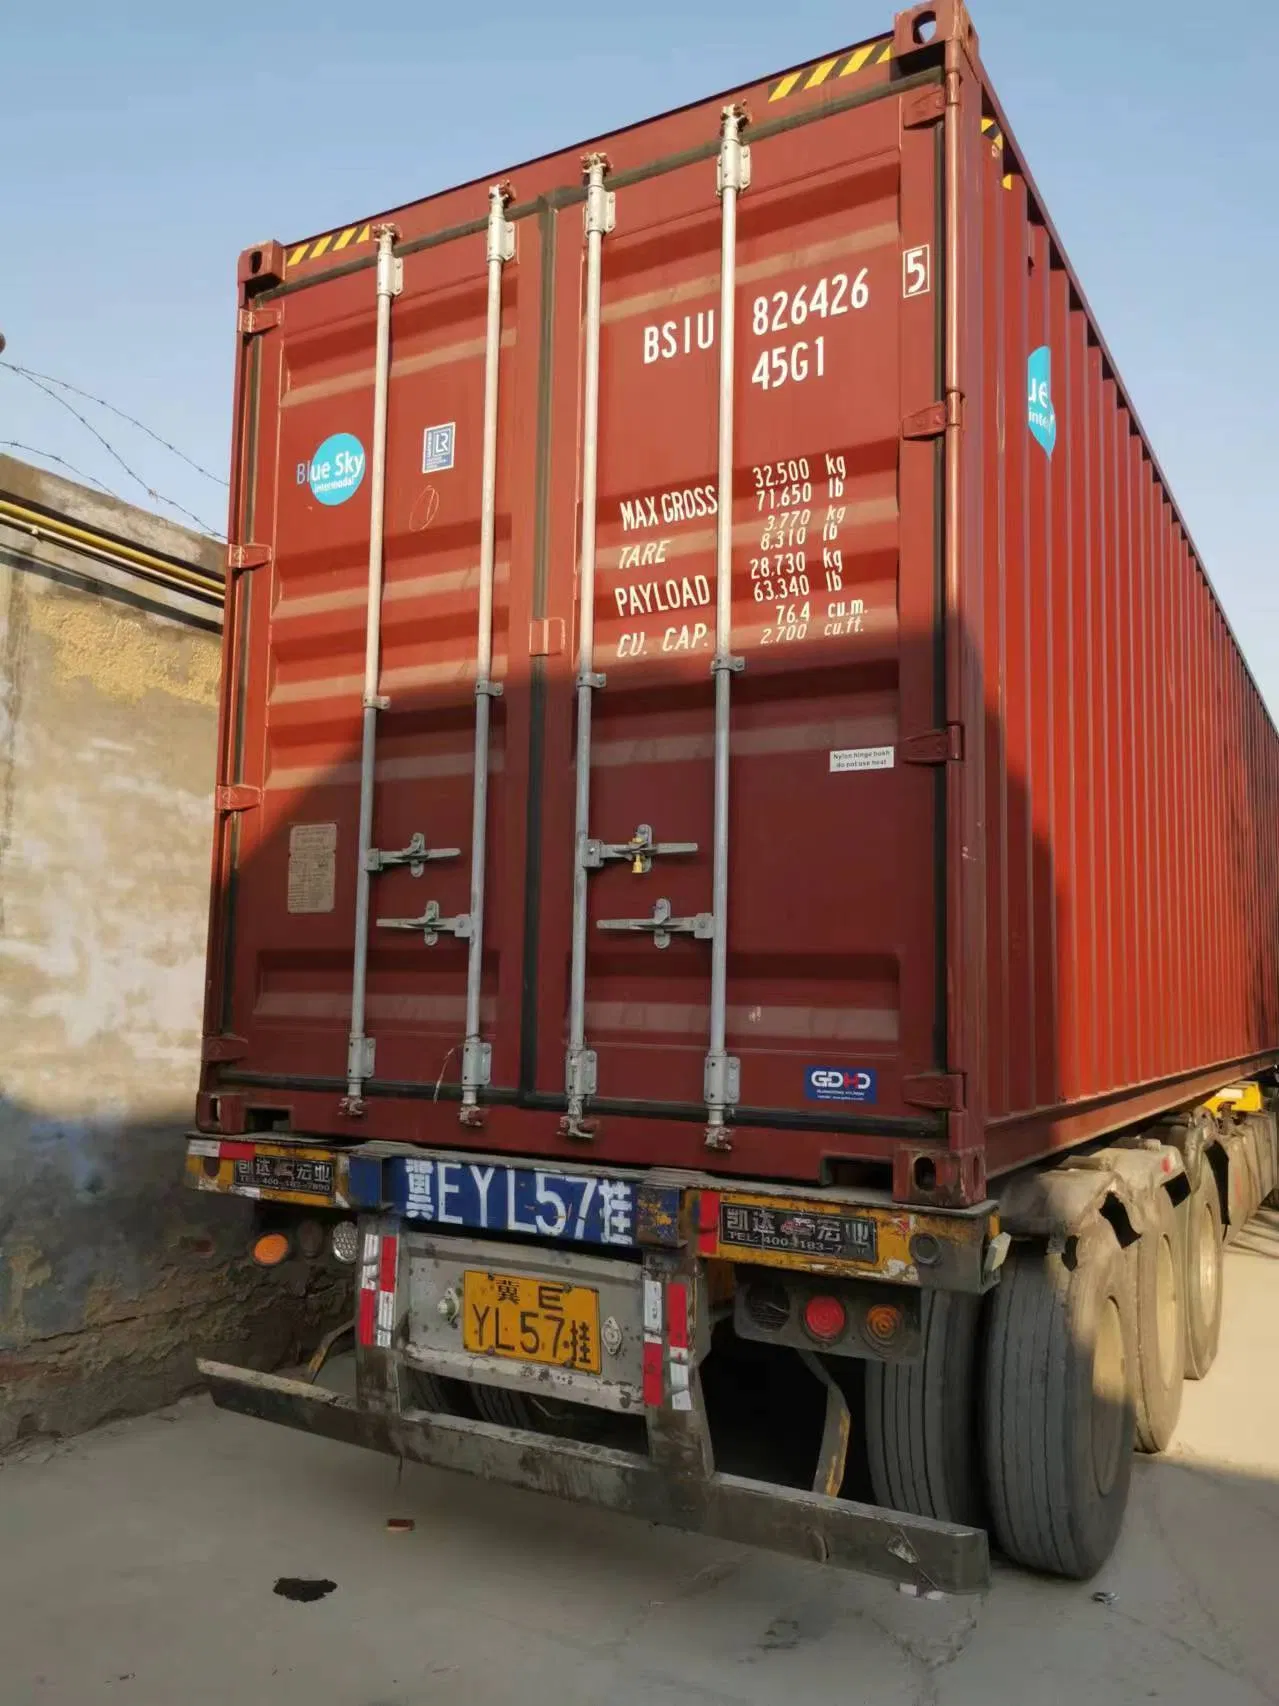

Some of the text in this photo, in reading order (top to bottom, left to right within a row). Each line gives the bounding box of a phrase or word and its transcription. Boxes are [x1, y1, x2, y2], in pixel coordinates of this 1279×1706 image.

[643, 248, 927, 364] BSIU 826426 5
[752, 336, 824, 390] 45G1
[296, 450, 364, 485] Blue Sky
[825, 453, 846, 480] kg
[828, 478, 843, 498] lb
[620, 485, 718, 531] MAX GROSS
[826, 505, 846, 524] kg
[823, 524, 838, 542] lb
[618, 539, 672, 569] TARE
[823, 548, 843, 572] kg
[614, 574, 710, 617] PAYLOAD
[825, 571, 842, 592] lb
[776, 601, 810, 625] 76.4
[662, 623, 708, 652] CAP.
